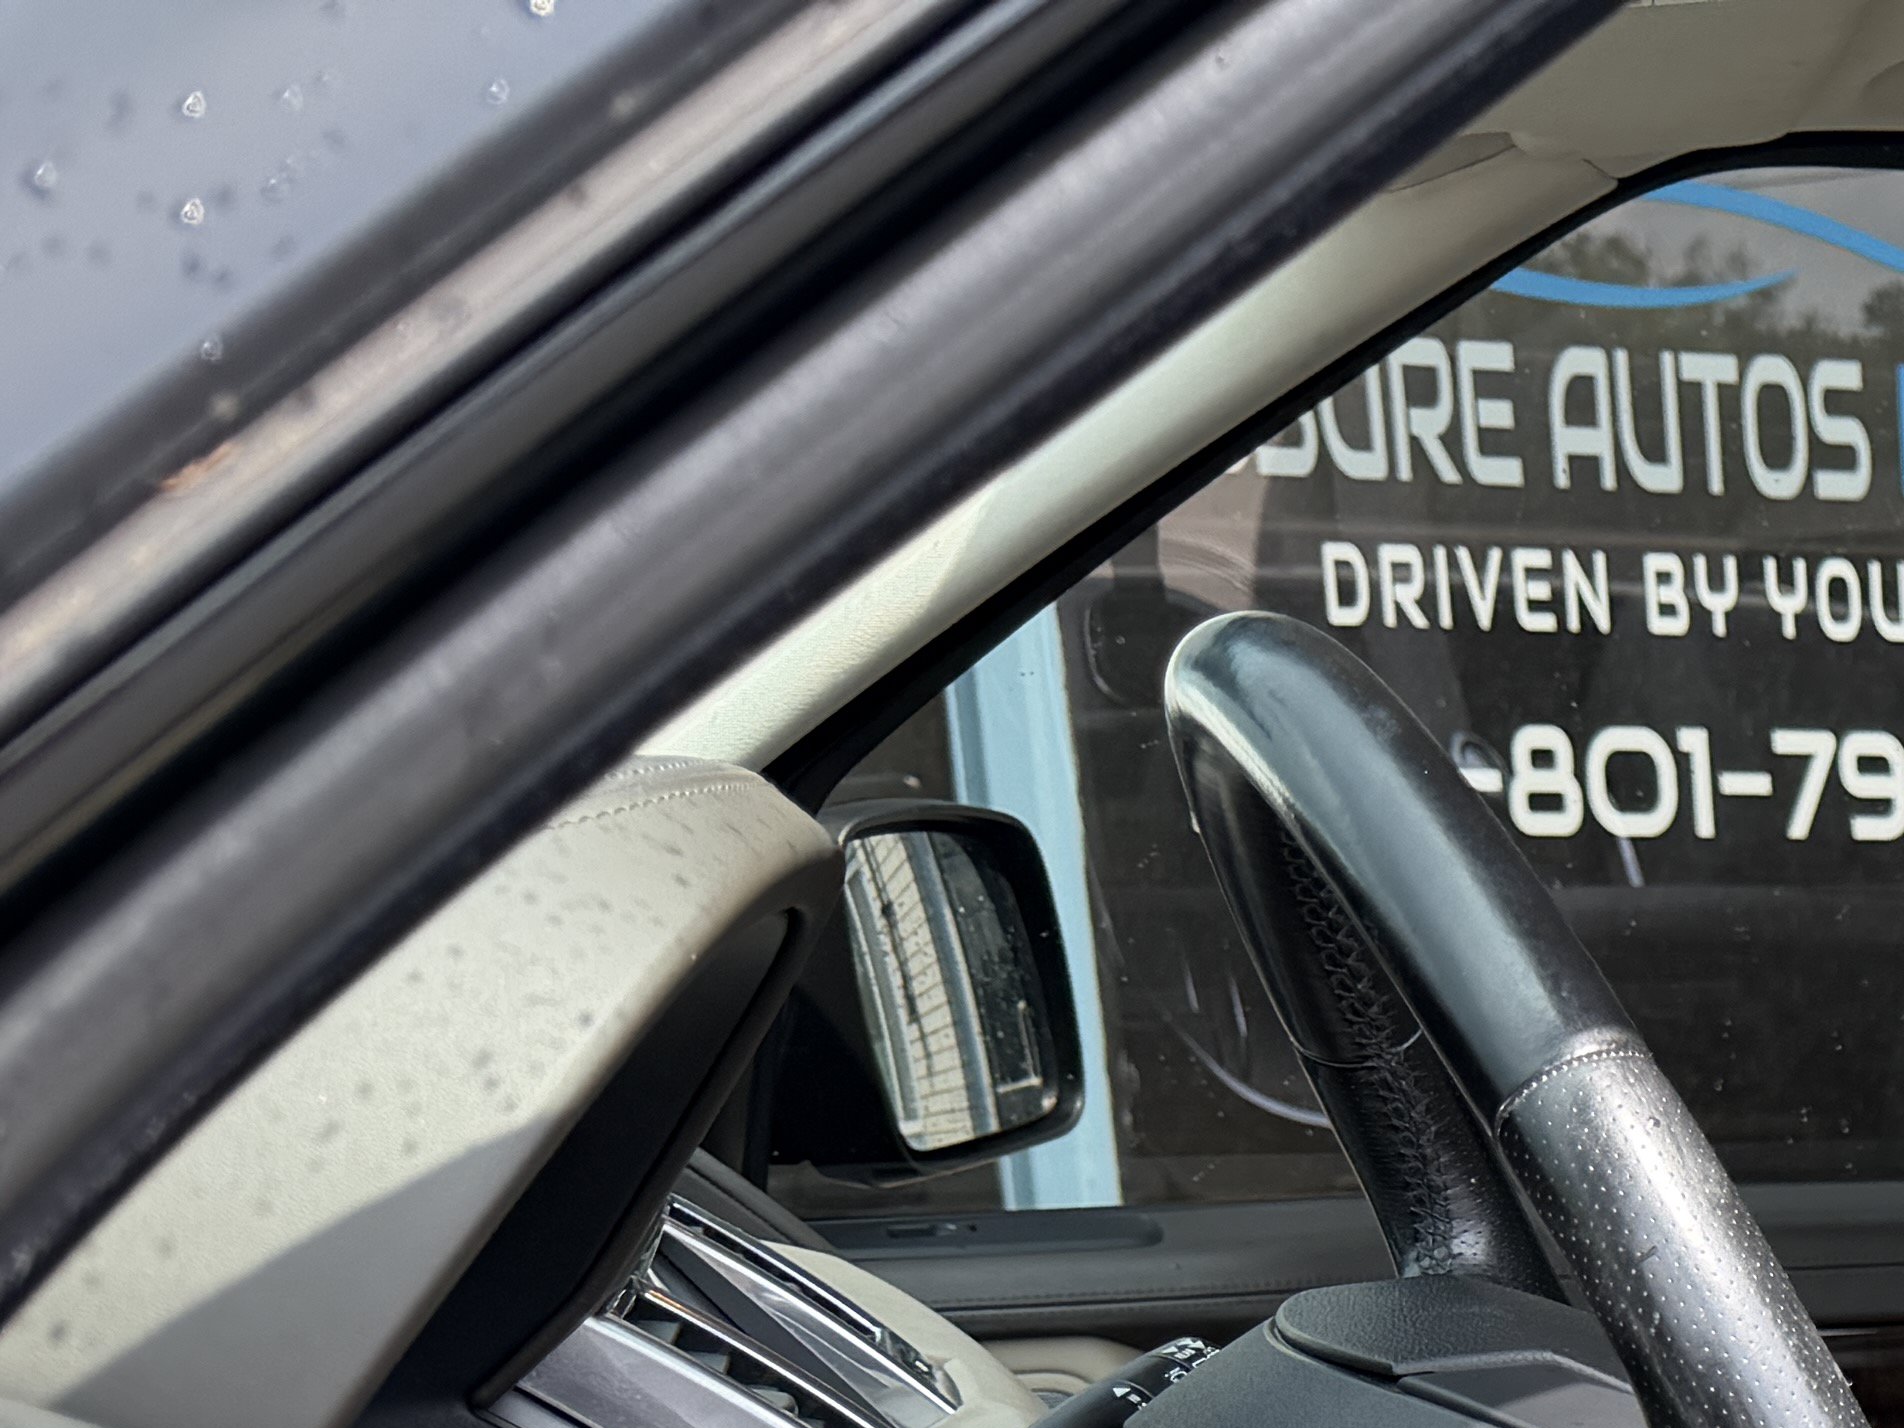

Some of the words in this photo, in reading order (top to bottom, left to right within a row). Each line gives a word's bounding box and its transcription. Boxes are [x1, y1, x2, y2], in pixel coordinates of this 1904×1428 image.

[1549, 346, 1874, 502] AUTOS
[1322, 543, 1613, 634] DRIVEN
[1645, 552, 1740, 639] BY
